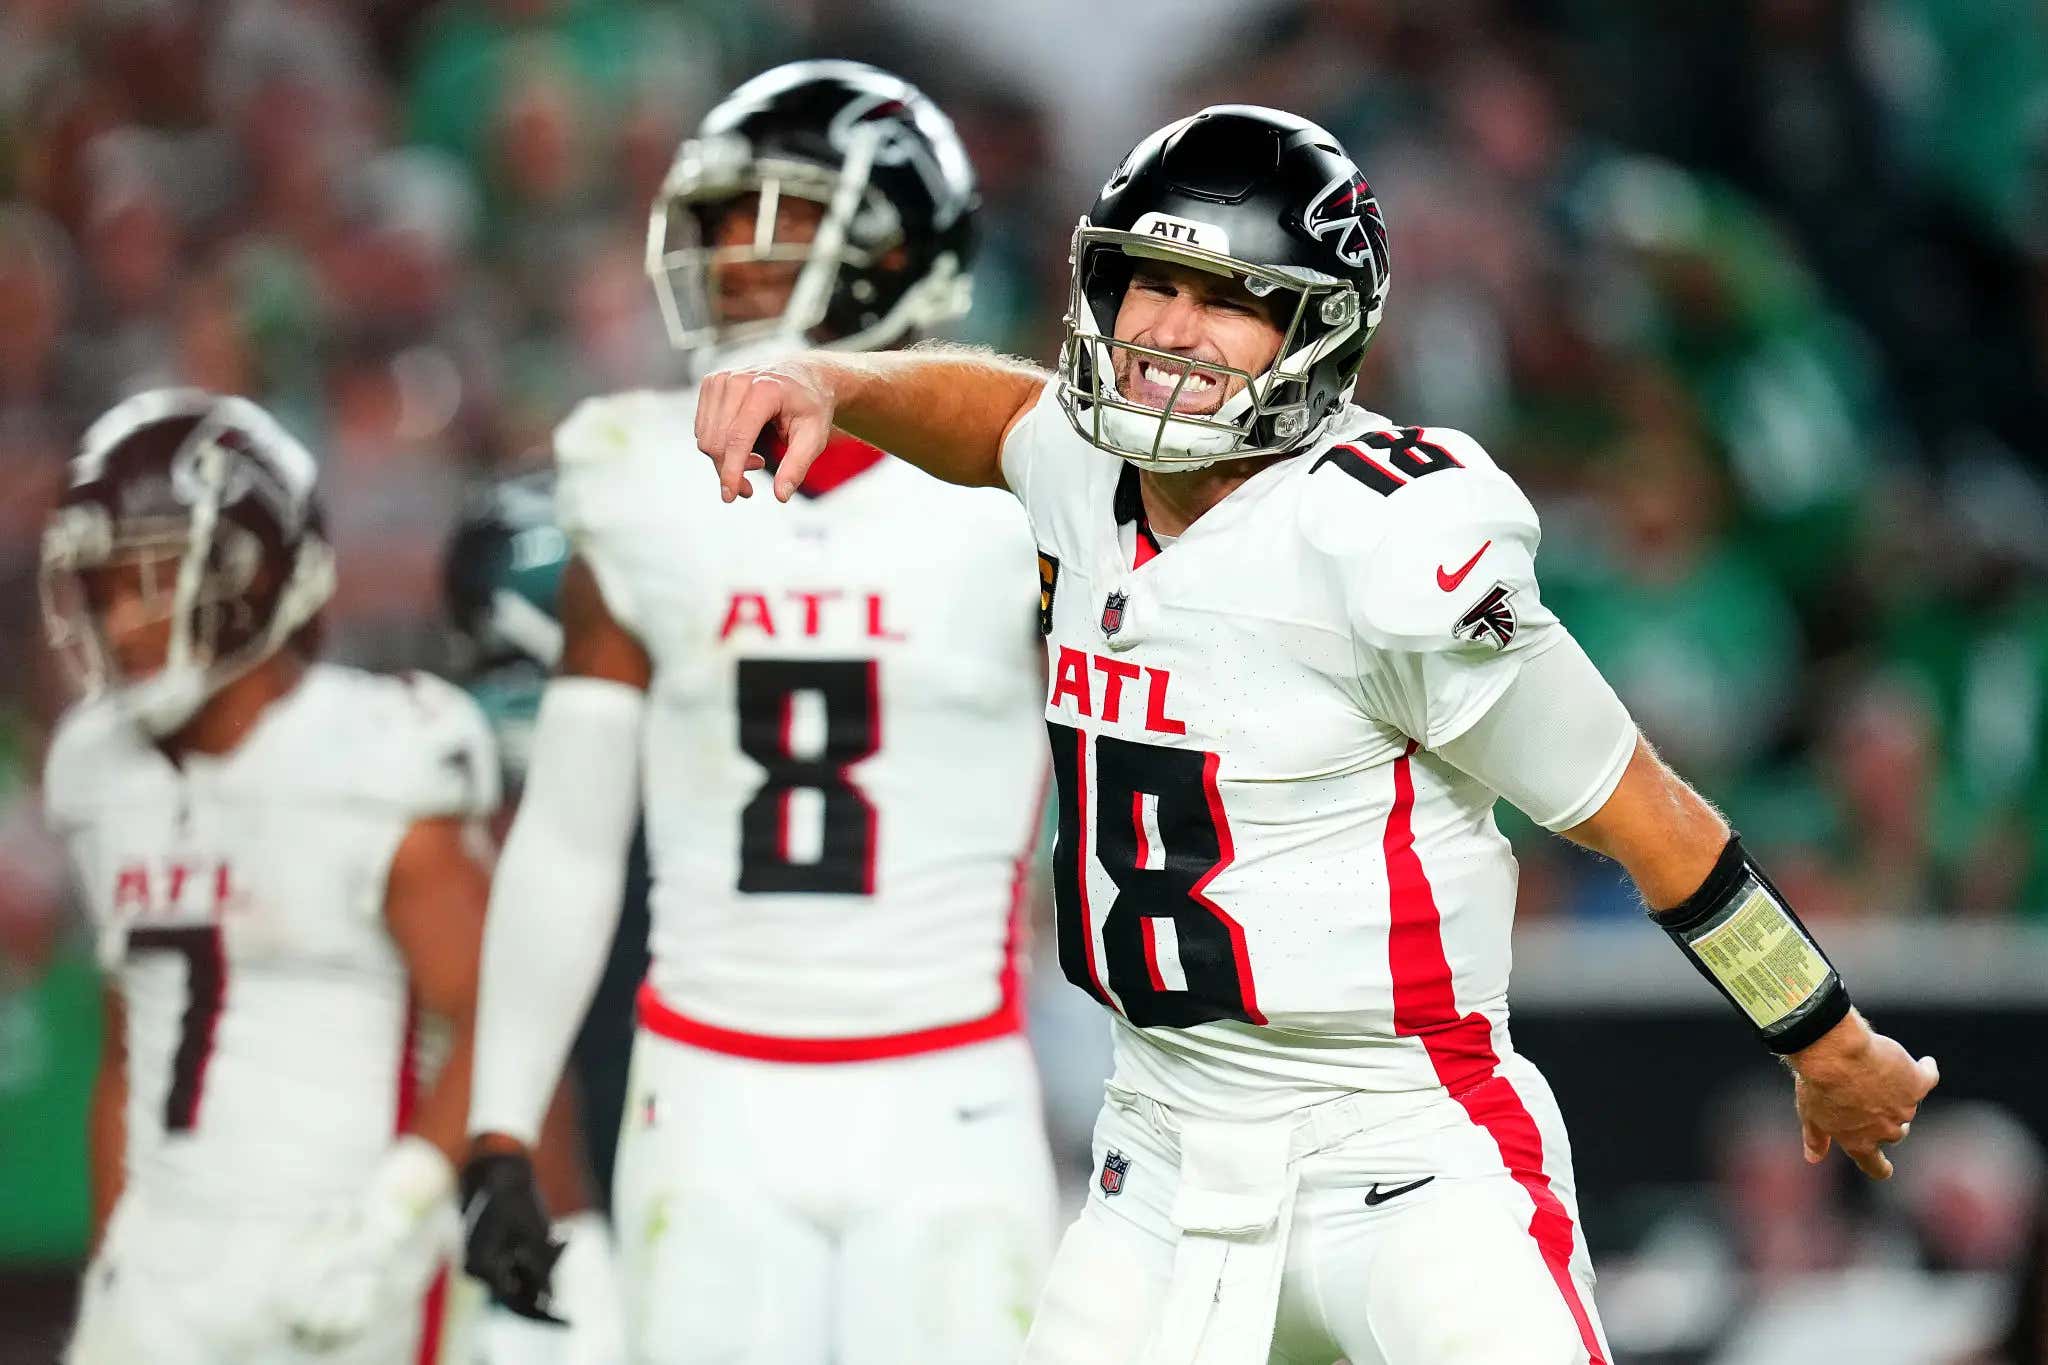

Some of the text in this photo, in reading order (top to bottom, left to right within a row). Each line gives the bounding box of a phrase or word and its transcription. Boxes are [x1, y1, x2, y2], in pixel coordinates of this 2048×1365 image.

[1150, 221, 1200, 244] ATL
[1308, 425, 1466, 498] 18
[720, 590, 907, 642] ATL
[1051, 645, 1186, 735] ATL
[737, 659, 882, 895] 8
[1046, 720, 1269, 1029] 18
[127, 926, 228, 1133] 7
